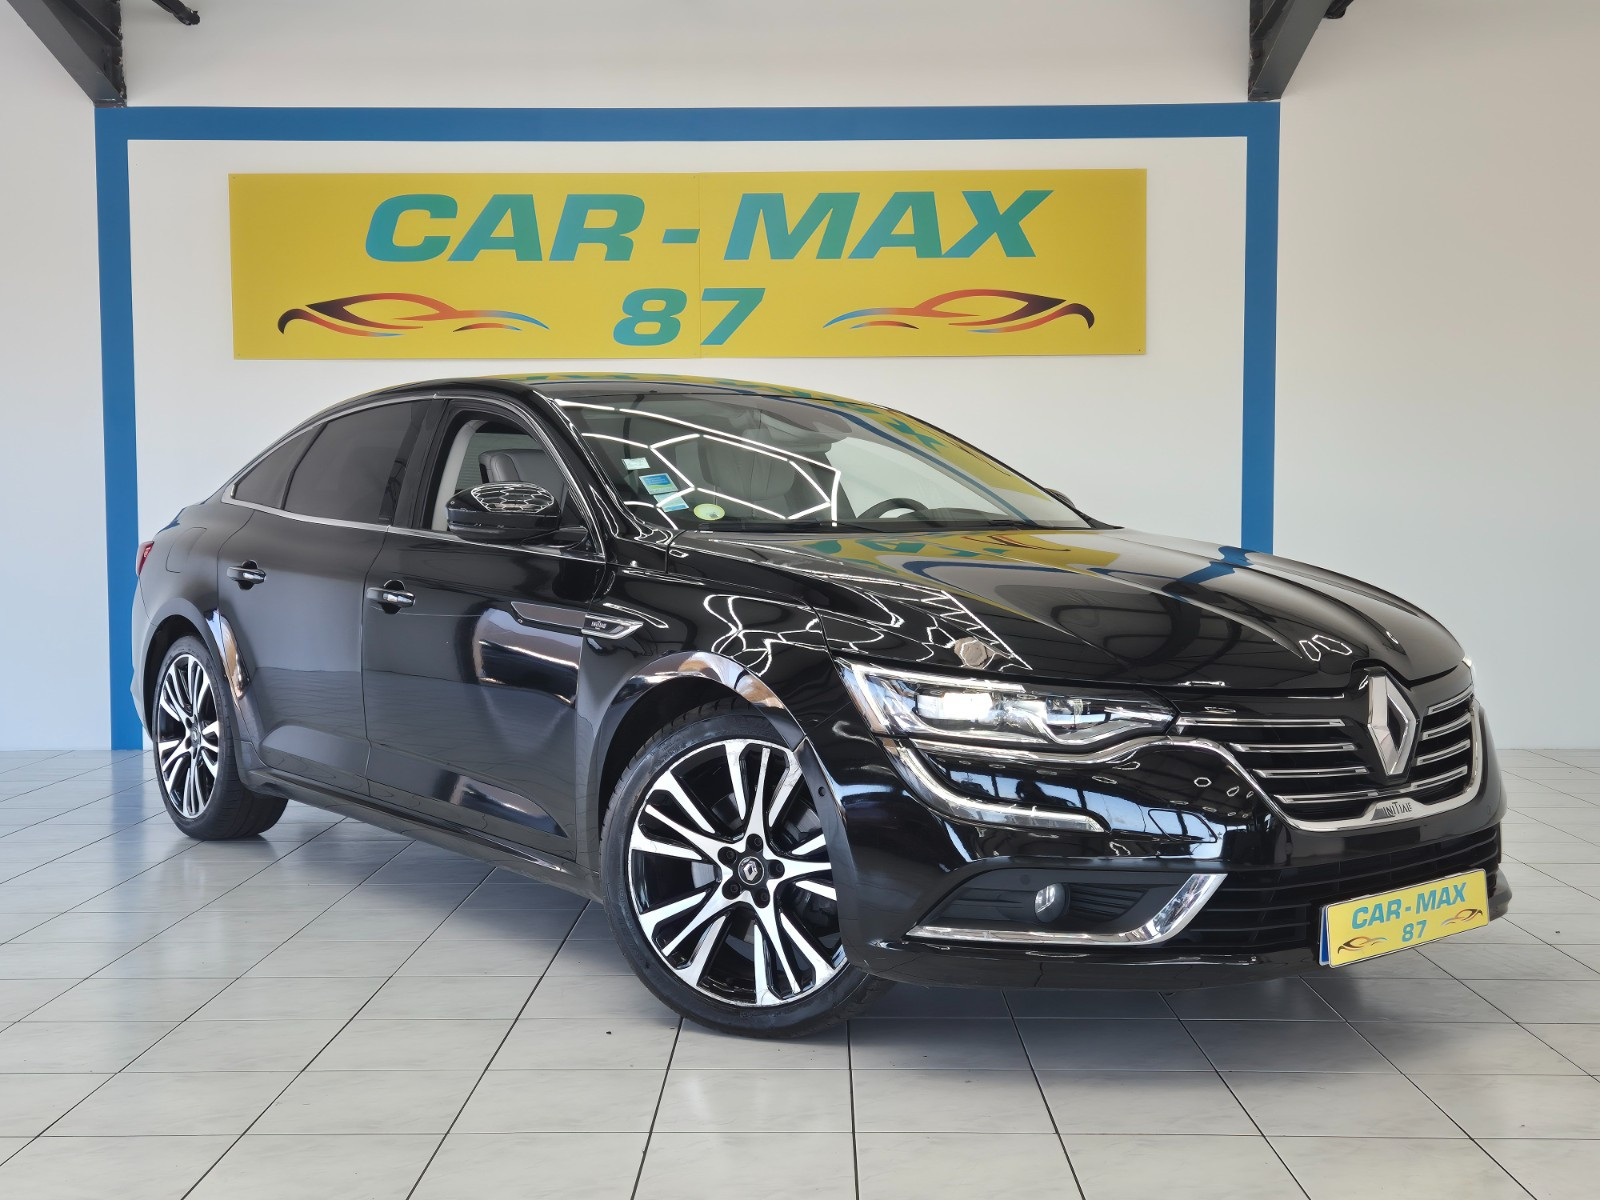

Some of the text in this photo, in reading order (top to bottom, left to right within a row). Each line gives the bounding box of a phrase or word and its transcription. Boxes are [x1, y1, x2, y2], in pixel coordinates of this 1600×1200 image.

[366, 194, 645, 262] CAR
[725, 190, 1052, 260] MAX
[614, 288, 765, 346] 87
[1401, 919, 1427, 942] 87
